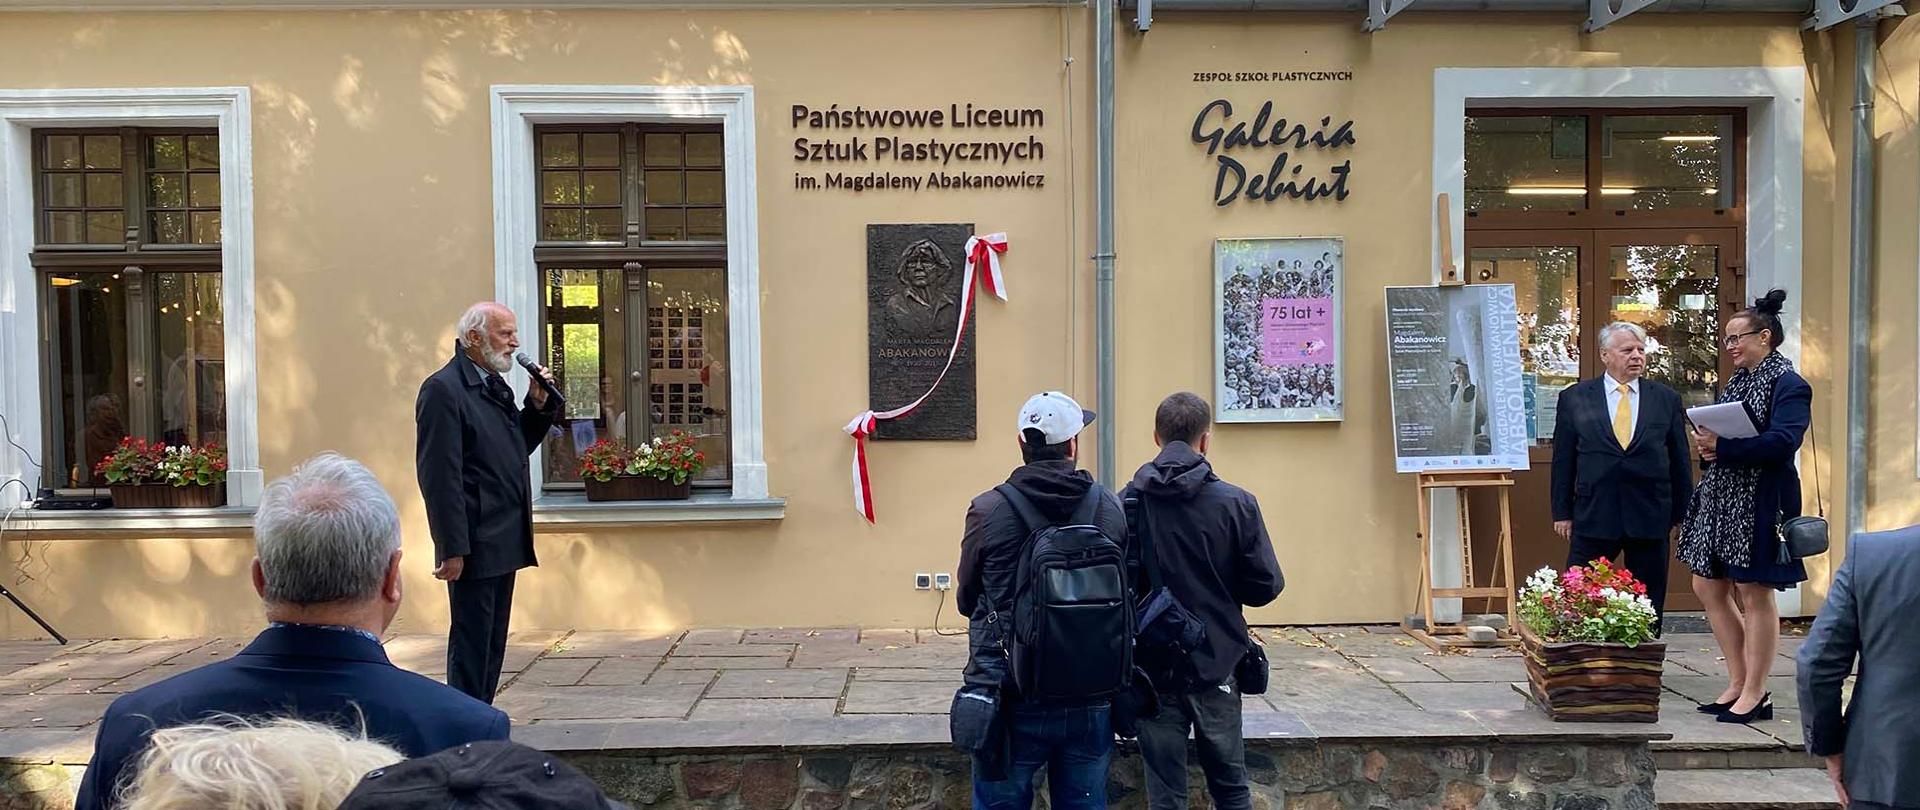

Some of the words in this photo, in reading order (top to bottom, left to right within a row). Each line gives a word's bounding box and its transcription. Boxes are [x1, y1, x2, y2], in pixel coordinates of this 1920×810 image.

[1272, 71, 1353, 81] PLASTYCZNYCH
[792, 103, 944, 128] Państwowe
[950, 103, 1044, 128] Liceum
[1191, 99, 1356, 155] Galeria
[794, 137, 869, 161] Sztuk
[874, 135, 1044, 166] Plastycznych
[795, 172, 821, 189] im.
[825, 171, 923, 192] Magdaleny
[926, 171, 1045, 189] Abakanowicz
[1214, 151, 1351, 207] Debiut
[1270, 307, 1288, 319] 75
[1291, 306, 1312, 319] lat
[1394, 335, 1447, 344] Abakanowicz
[1494, 384, 1511, 455] MAGDALENA
